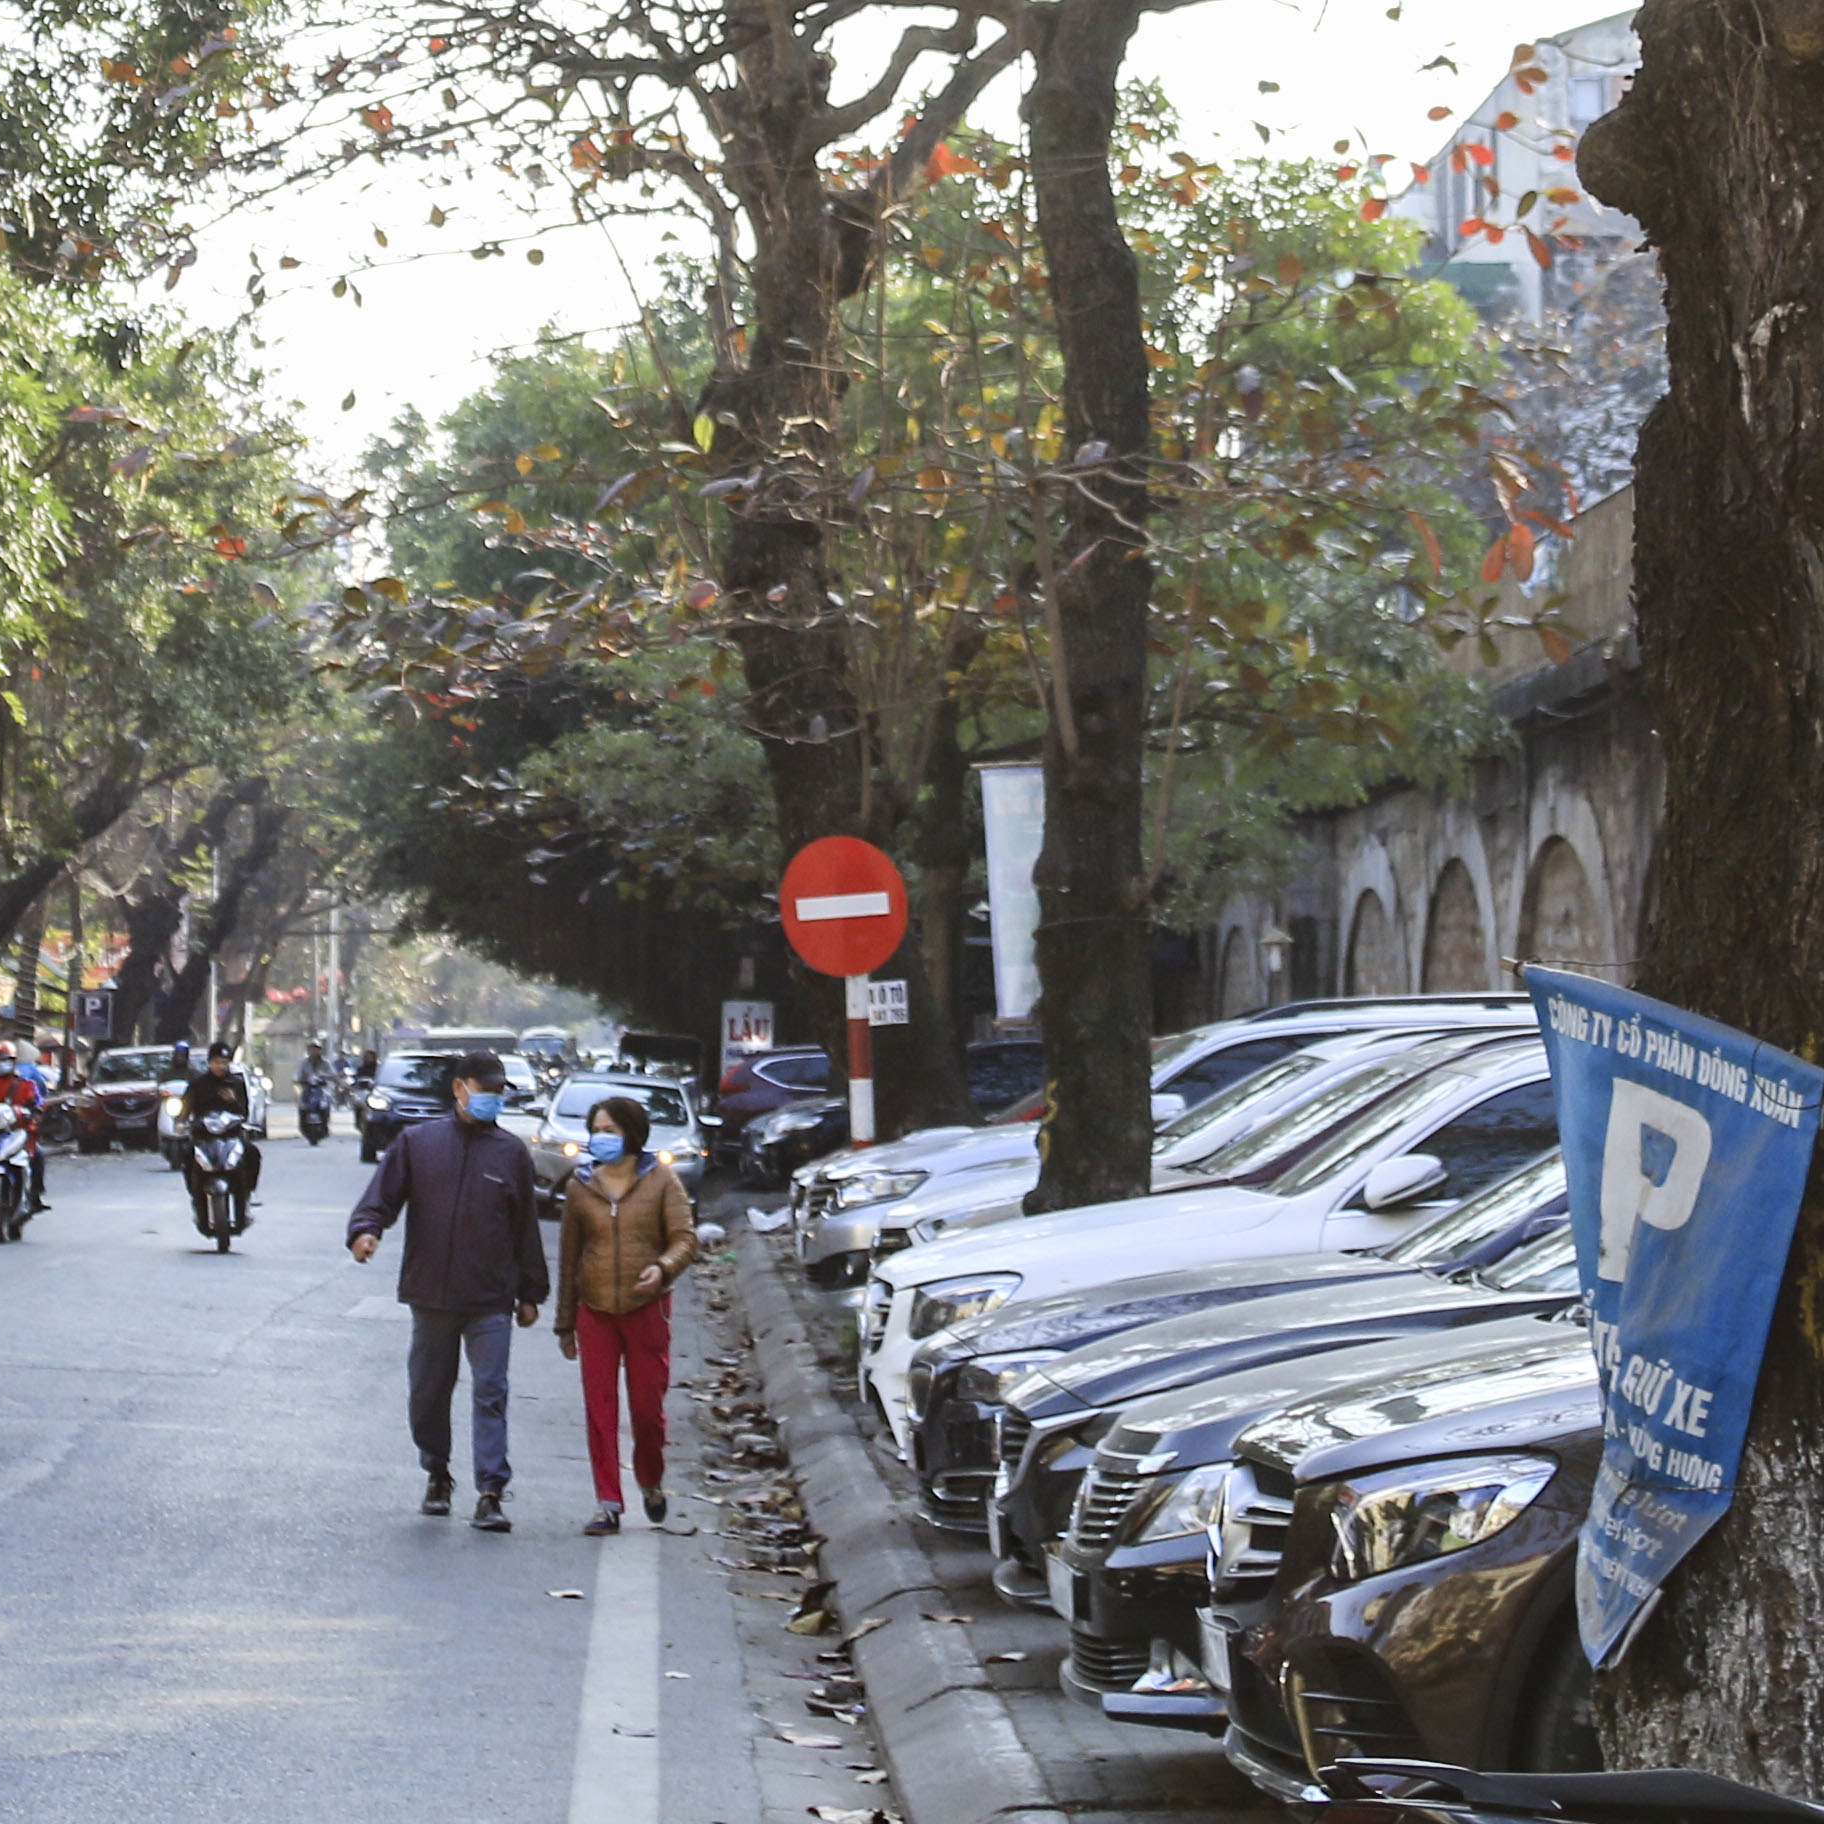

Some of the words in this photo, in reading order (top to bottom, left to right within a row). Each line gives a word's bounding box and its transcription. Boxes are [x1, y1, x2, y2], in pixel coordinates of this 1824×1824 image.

[85, 996, 102, 1017] P
[1547, 992, 1589, 1043] CÔNG
[1592, 1010, 1613, 1049] TY
[1617, 1012, 1642, 1058] CỔ
[1749, 1073, 1804, 1128] XUÂN
[1597, 1076, 1713, 1284] P
[1663, 1378, 1714, 1438] XE
[1666, 1447, 1724, 1495] HƯNG
